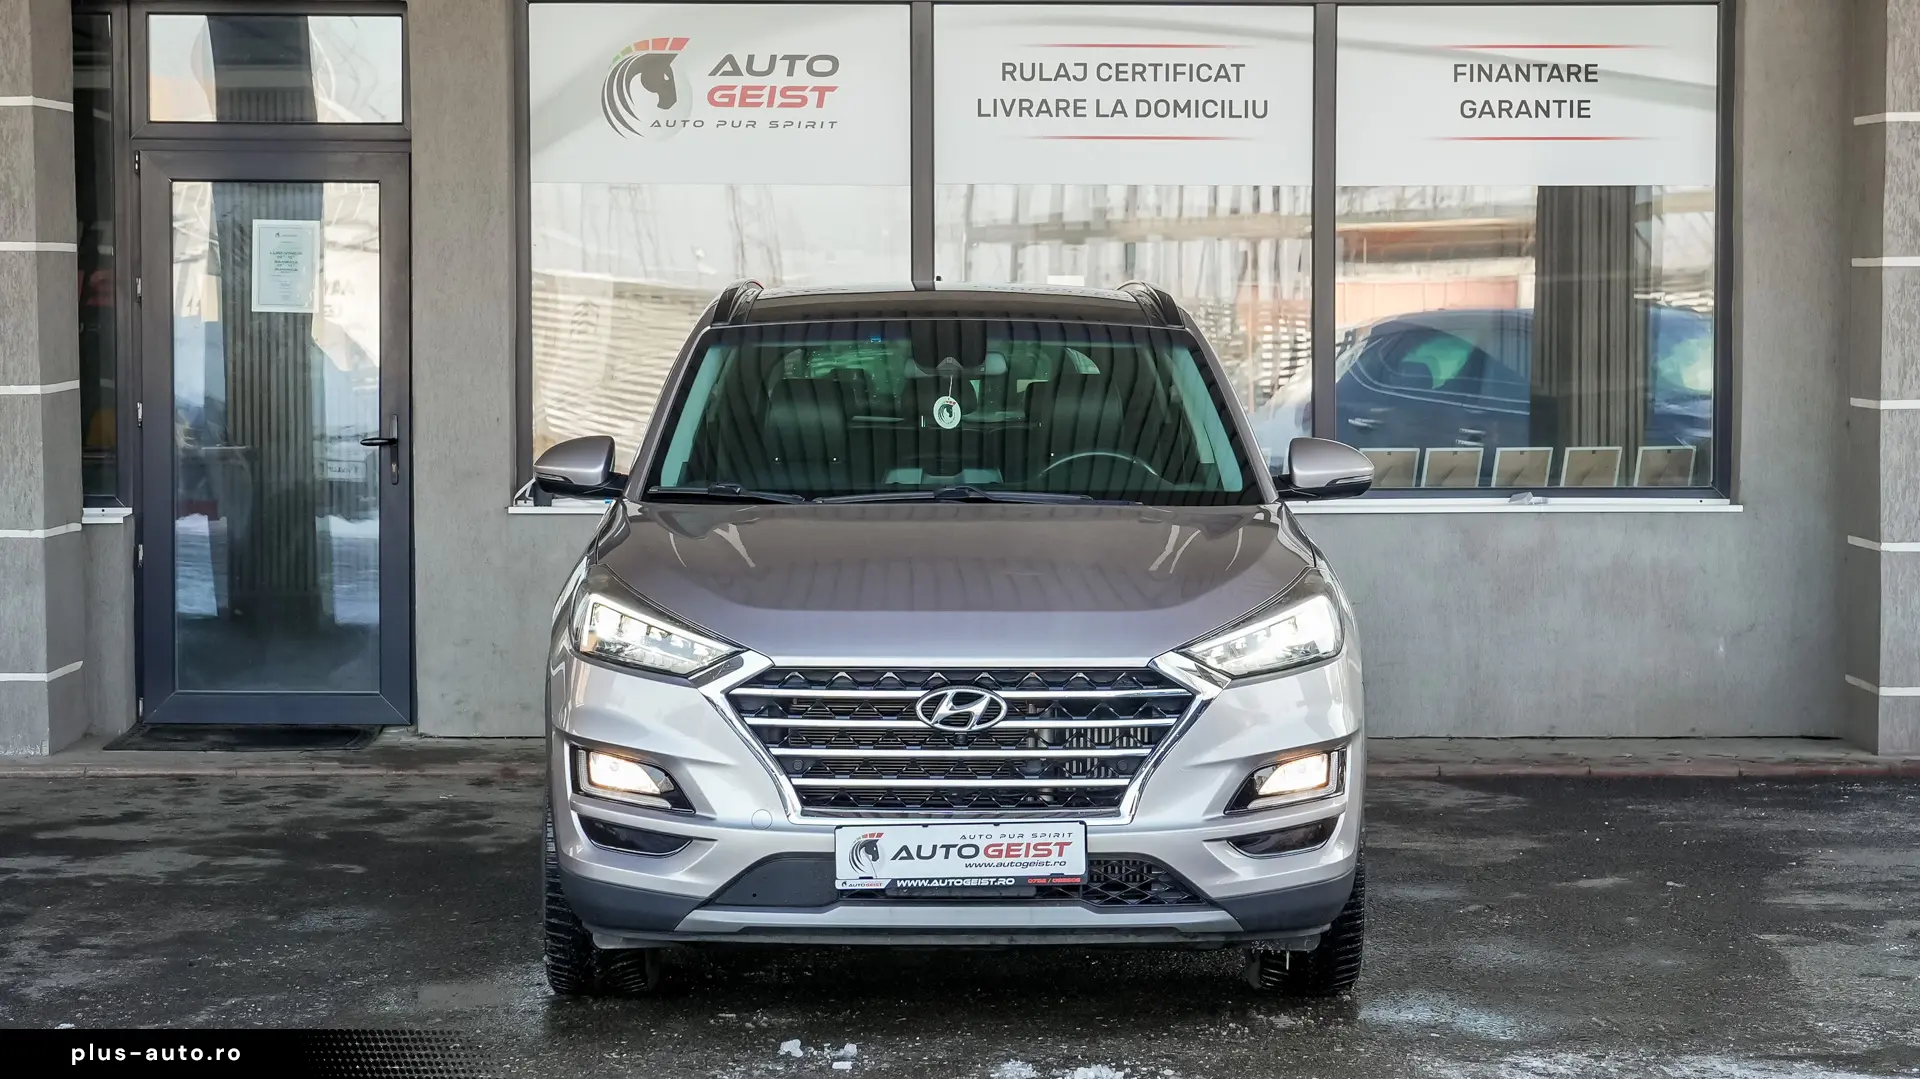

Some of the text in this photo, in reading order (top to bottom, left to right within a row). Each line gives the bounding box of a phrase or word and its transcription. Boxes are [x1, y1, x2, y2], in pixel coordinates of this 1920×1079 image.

[708, 53, 840, 78] AUTO
[1002, 62, 1246, 83] RULAJ CERTIFICAT
[1453, 63, 1599, 83] FINANTARE
[707, 84, 839, 109] GEIST
[977, 98, 1268, 119] LIVRARE LA DOMICILIU
[1460, 99, 1591, 119] GARANTIE
[650, 119, 838, 130] AUTO PUR SPIRIT
[964, 860, 1066, 869] www.autogeist.ro
[896, 878, 1015, 887] WWW.AUTOGEIST.RO
